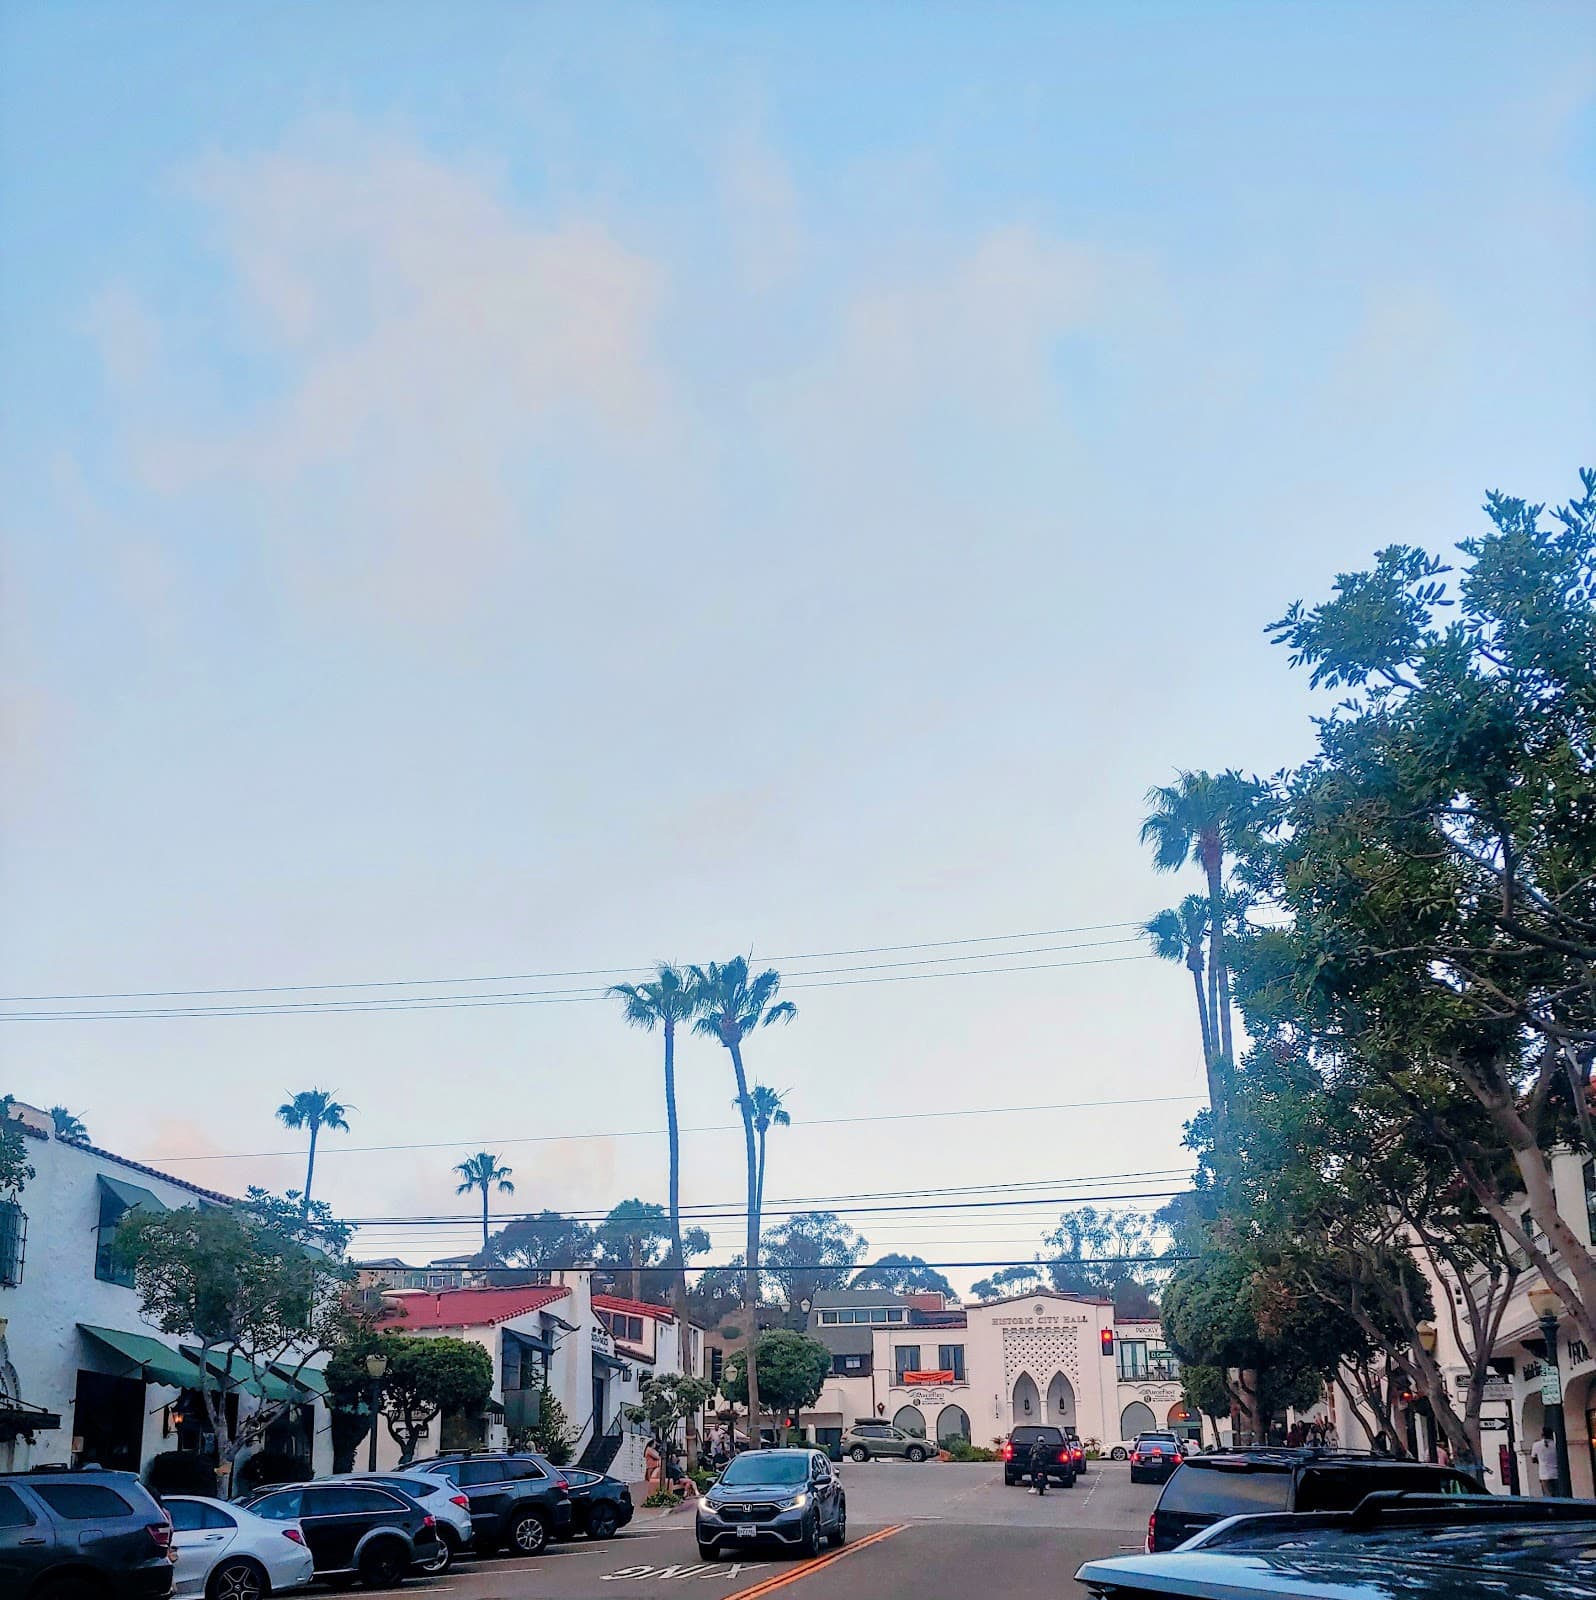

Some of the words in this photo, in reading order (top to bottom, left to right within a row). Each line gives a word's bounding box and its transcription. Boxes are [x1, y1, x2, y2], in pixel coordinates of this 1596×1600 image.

[992, 1317, 1033, 1326] HISTORIC
[1038, 1316, 1059, 1324] CITY
[1063, 1315, 1088, 1323] HALL
